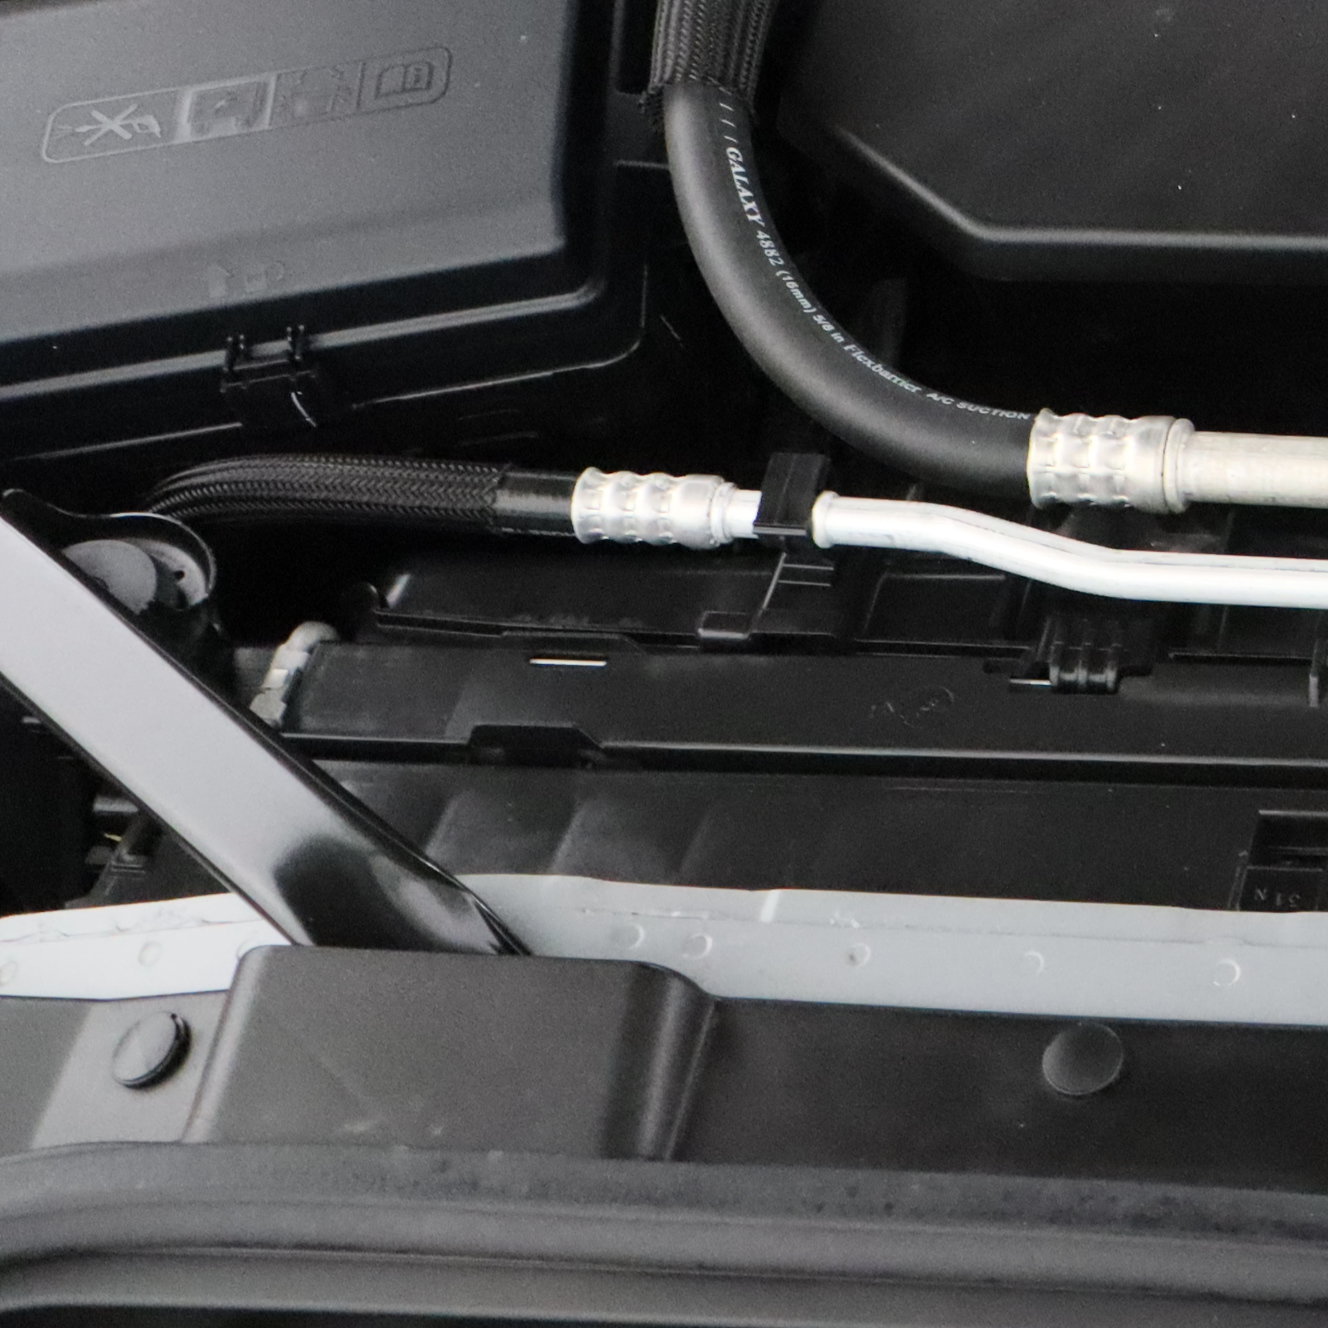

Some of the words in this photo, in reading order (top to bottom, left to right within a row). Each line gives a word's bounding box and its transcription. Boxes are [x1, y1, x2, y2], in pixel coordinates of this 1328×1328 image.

[725, 146, 765, 229] GALAXY
[755, 229, 786, 268] 4882
[775, 269, 817, 314] (16mm)
[926, 391, 956, 406] A/C
[956, 401, 1031, 421] SUCTION
